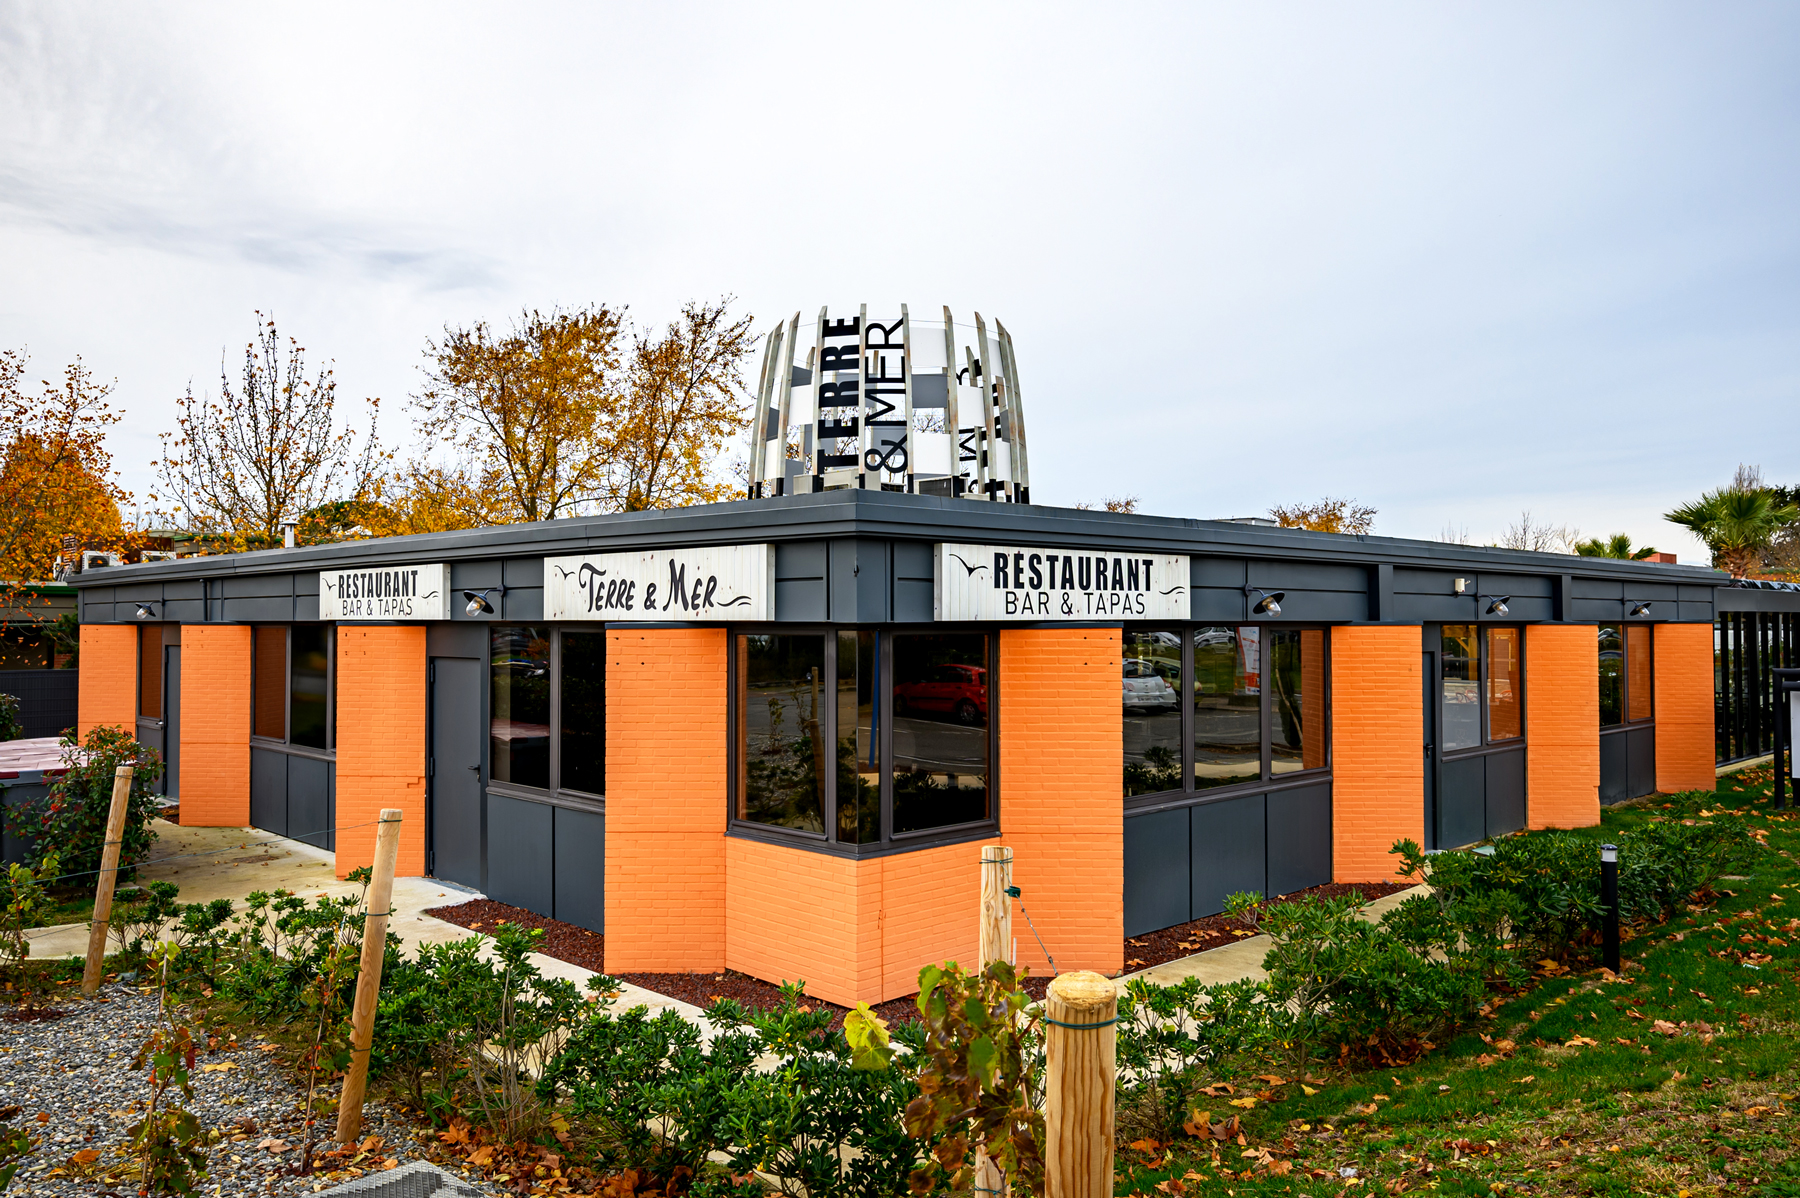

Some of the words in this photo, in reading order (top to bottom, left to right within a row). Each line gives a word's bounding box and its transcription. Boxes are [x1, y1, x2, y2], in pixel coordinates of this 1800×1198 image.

[864, 317, 907, 427] MER
[817, 316, 860, 475] TERRE
[864, 433, 908, 474] &
[338, 570, 418, 599] RESTAURANT
[578, 562, 636, 613] TERRE
[643, 582, 657, 611] &
[662, 558, 718, 612] MER
[993, 552, 1154, 592] RESTAURANT
[342, 599, 362, 617] BAR
[366, 599, 374, 616] &
[377, 598, 413, 617] TAPAS
[1005, 591, 1050, 615] BAR
[1060, 591, 1074, 615] &
[1083, 592, 1145, 615] TAPAS
